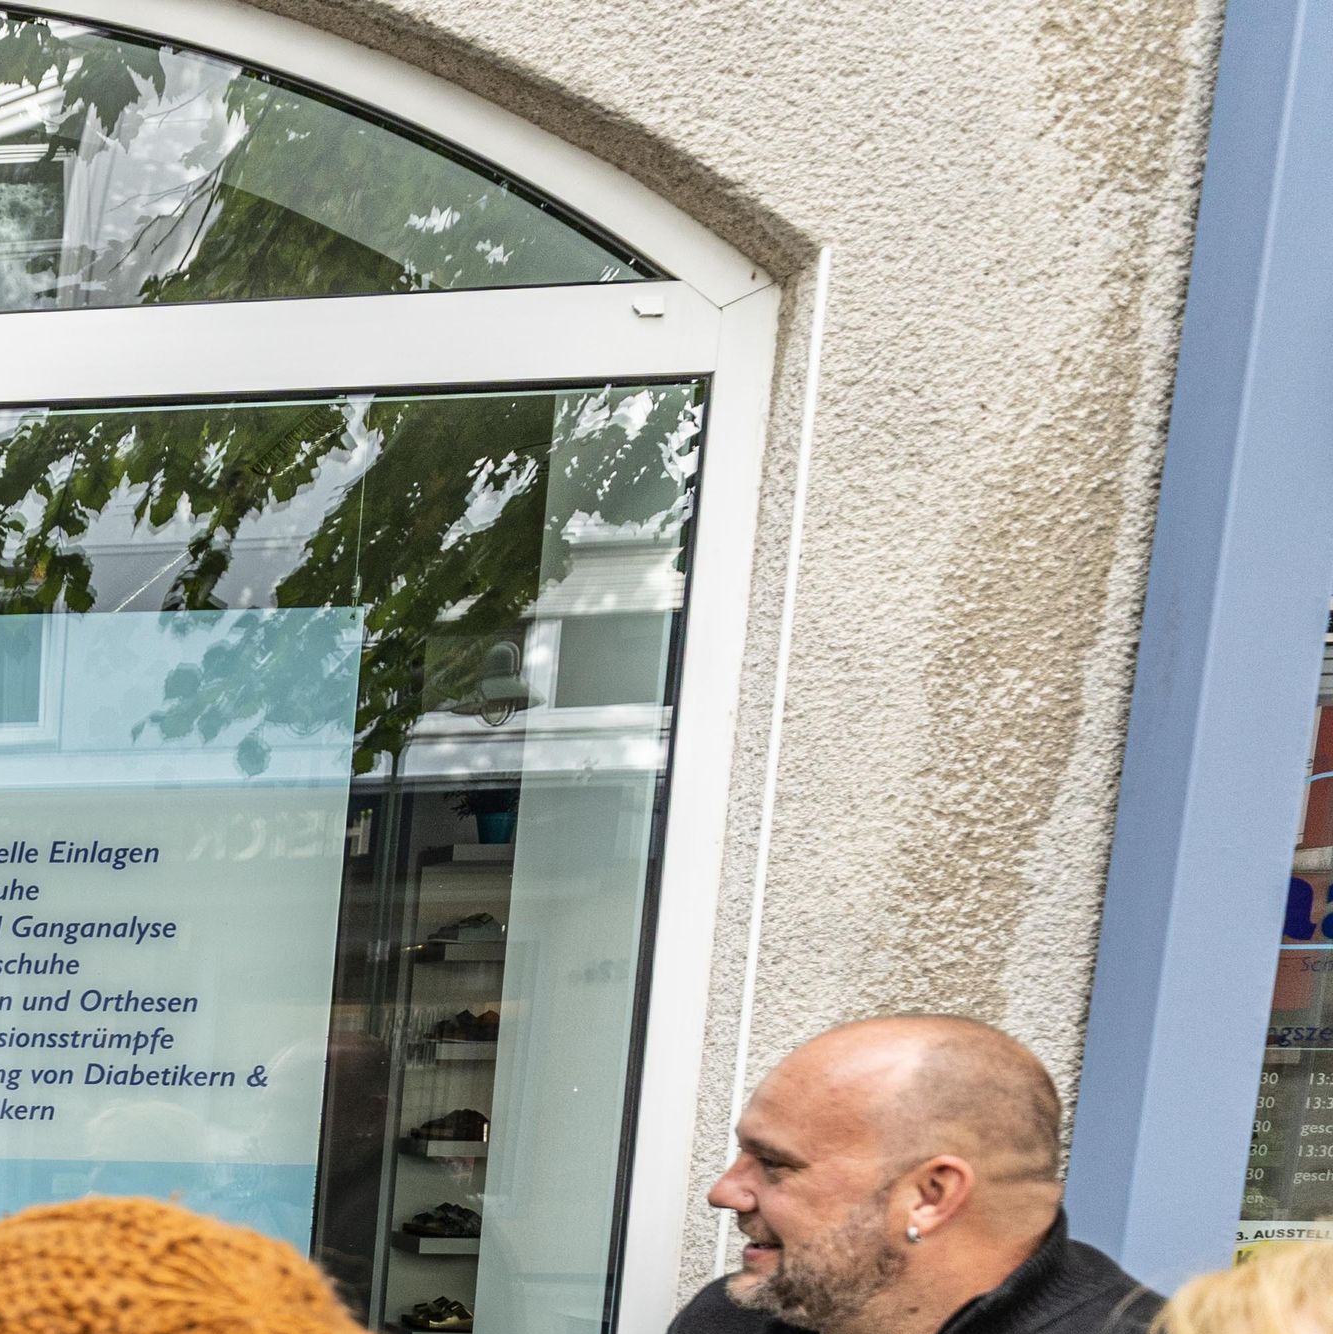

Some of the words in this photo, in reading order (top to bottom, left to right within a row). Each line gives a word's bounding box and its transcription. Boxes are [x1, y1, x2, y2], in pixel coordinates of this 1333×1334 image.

[49, 840, 159, 870] Einlagen
[11, 915, 177, 945] Ganganalyse
[22, 990, 70, 1012] und
[80, 989, 198, 1013] Orthesen
[31, 1068, 73, 1086] von
[84, 1063, 235, 1087] Diabetikern
[247, 1066, 269, 1088] &
